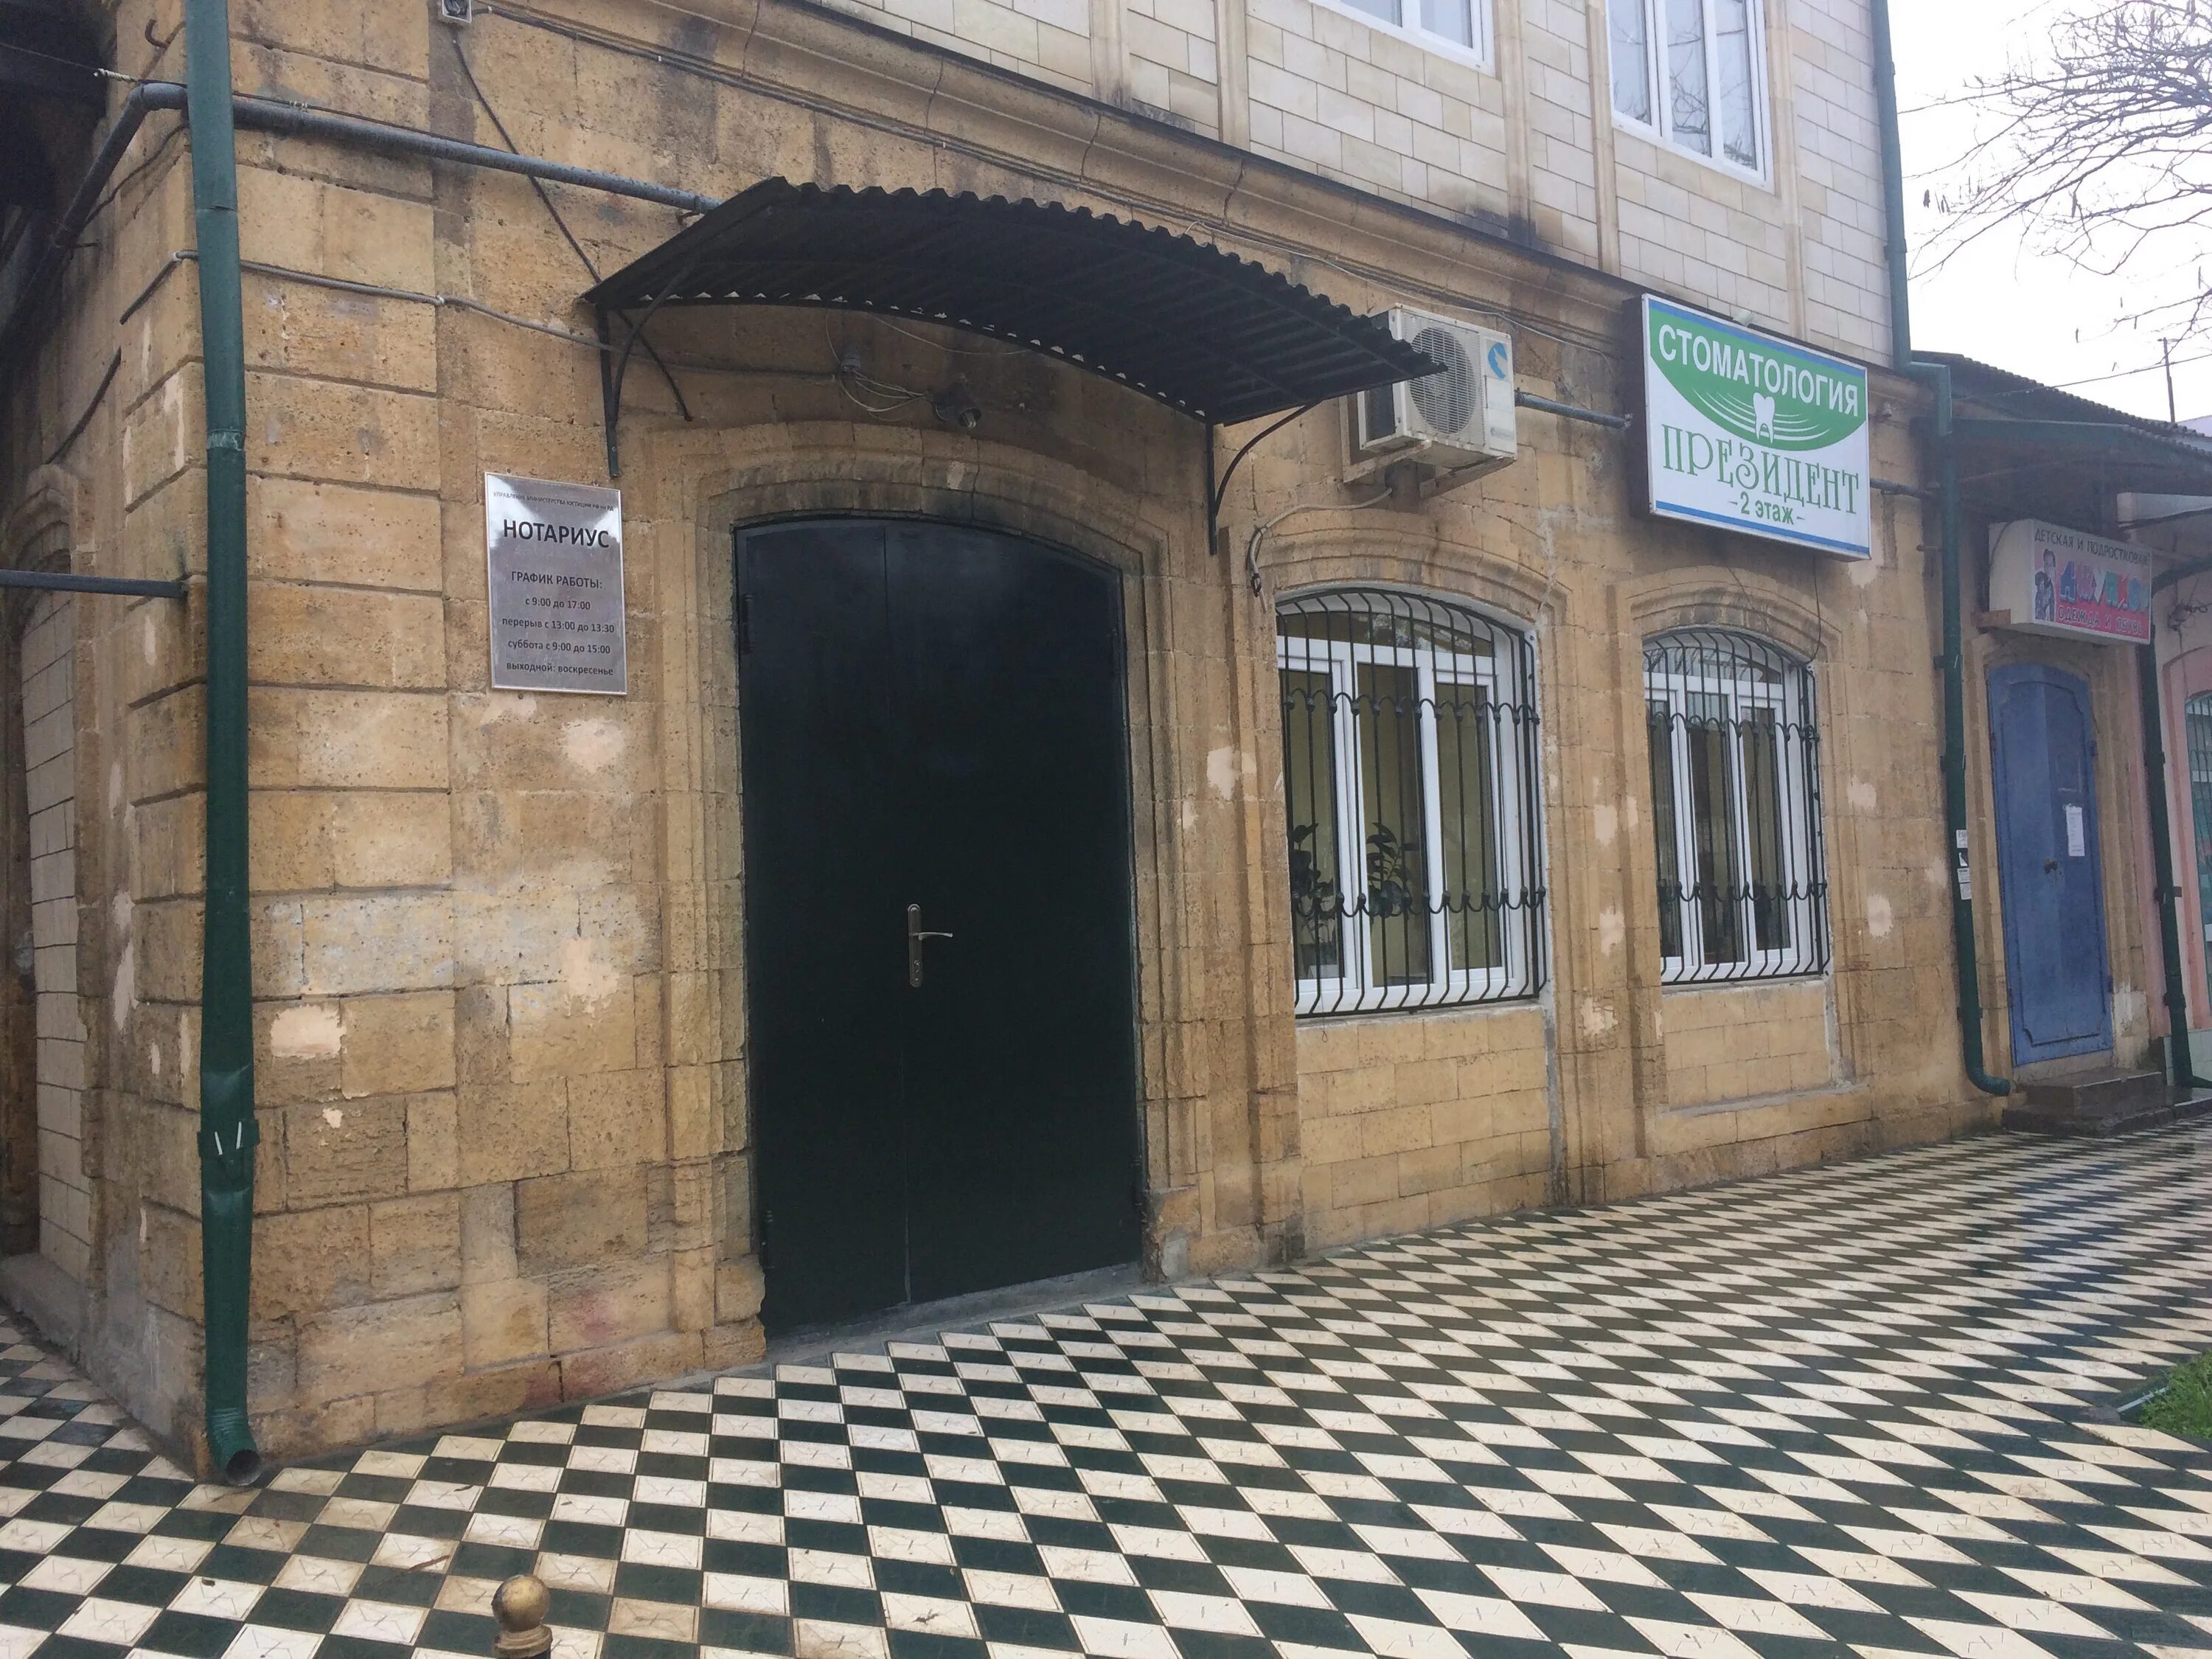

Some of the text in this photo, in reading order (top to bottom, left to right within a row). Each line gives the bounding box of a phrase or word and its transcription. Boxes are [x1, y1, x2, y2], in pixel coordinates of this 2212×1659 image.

[1659, 324, 1859, 417] СТОМАТОЛОГИЯ
[1661, 424, 1860, 514] ПРЕЗИДЕНТ
[504, 519, 610, 548] НОТАРИУС
[2034, 528, 2073, 549] ДЕТСКАЯ
[2077, 538, 2084, 551] И
[511, 571, 603, 589] ГРАФИК РАБОТЫ:
[532, 597, 551, 607] 9:00
[553, 600, 564, 609] до
[568, 600, 591, 611] 17:00
[502, 618, 542, 628] перерыв
[552, 621, 575, 630] 13:00
[577, 625, 588, 633] до
[591, 624, 614, 633] 13:30
[2058, 605, 2100, 627] ОДЕЖДА
[508, 639, 543, 650] суббота
[552, 641, 571, 652] 9:00
[573, 646, 585, 654] до
[588, 644, 611, 654] 15:00
[507, 662, 613, 675] выходной: воскресенье
